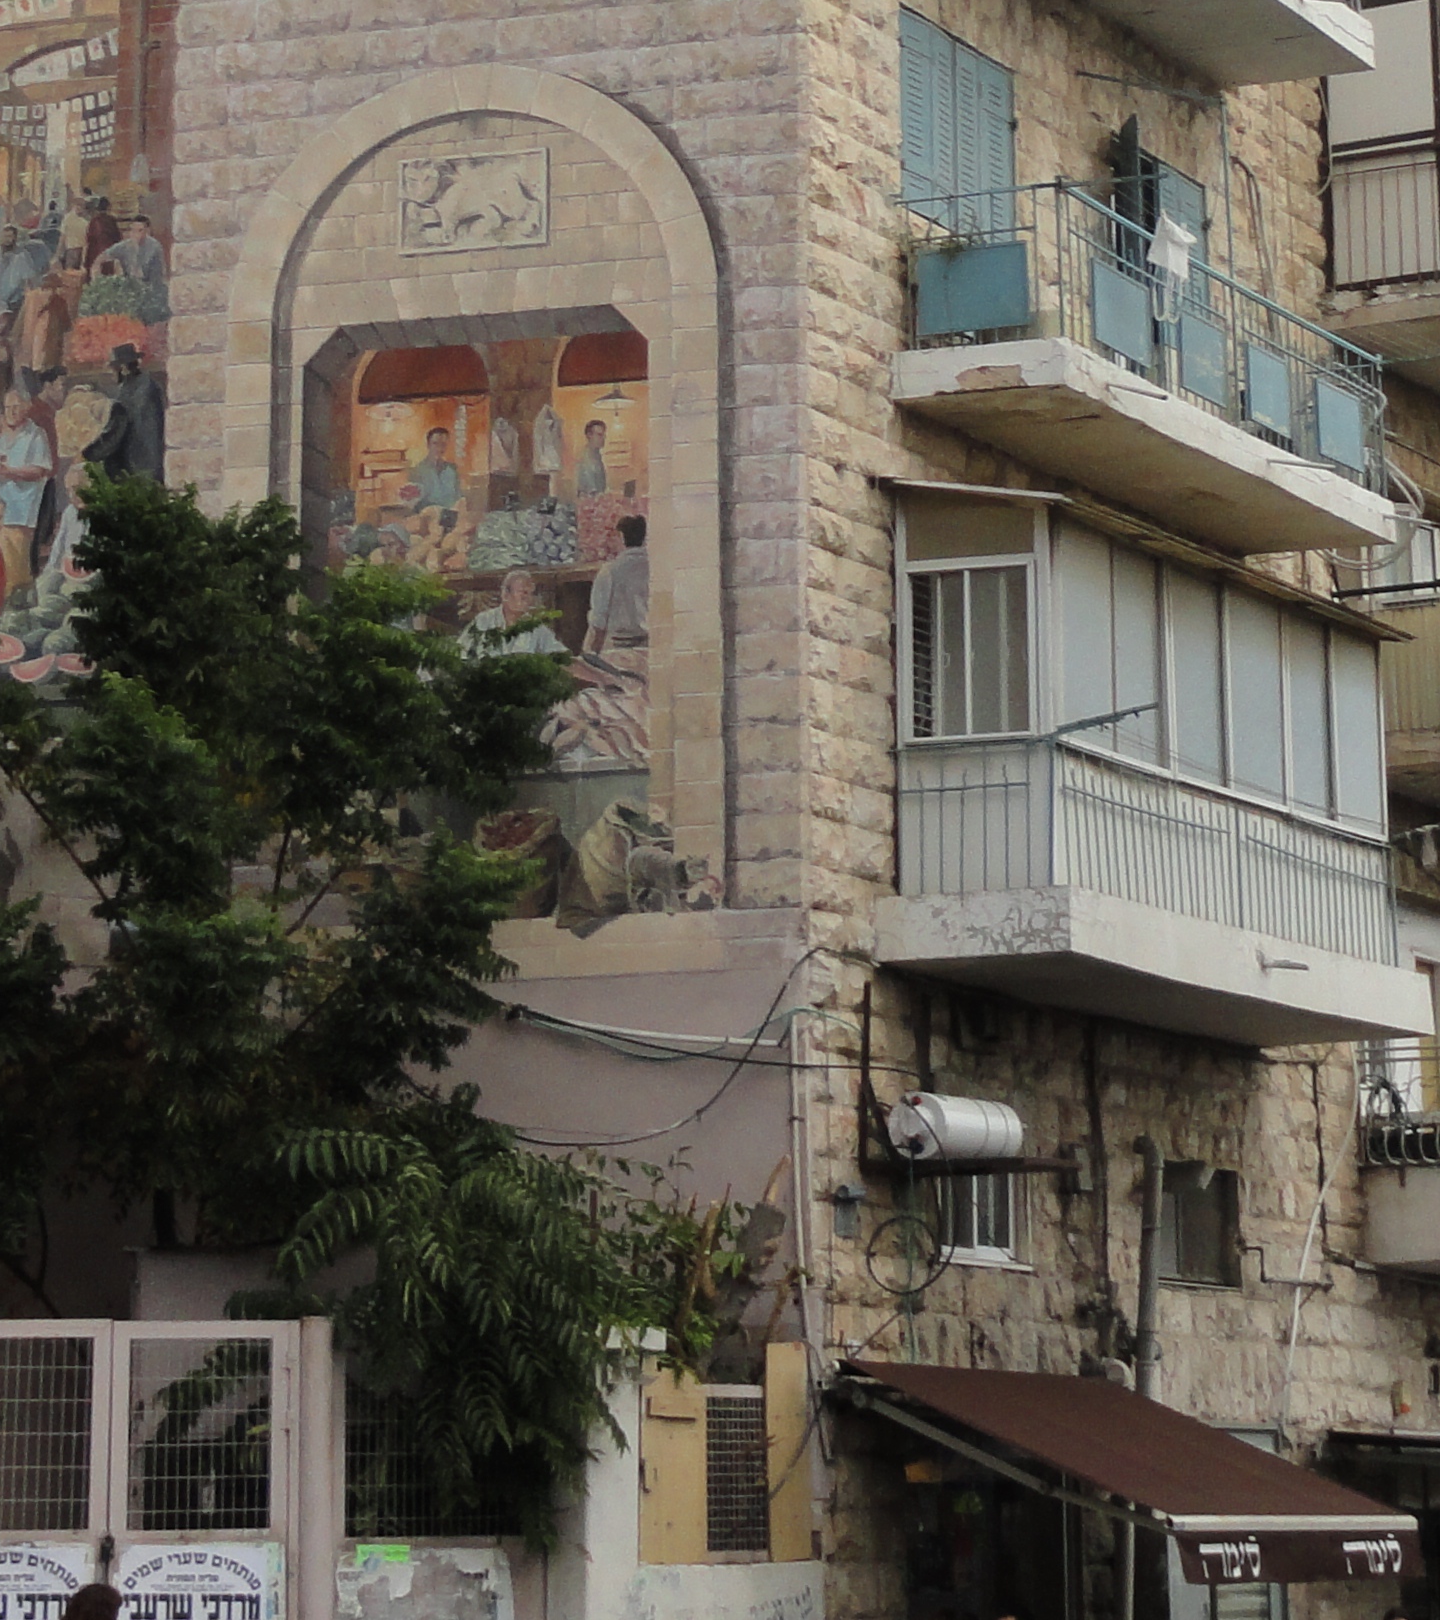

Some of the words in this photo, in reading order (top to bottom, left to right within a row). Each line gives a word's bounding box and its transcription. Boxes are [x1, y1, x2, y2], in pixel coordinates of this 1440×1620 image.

[26, 1553, 80, 1590] פותחים
[122, 1556, 164, 1590] שמים
[167, 1551, 209, 1565] שערי
[210, 1553, 262, 1591] פותחים
[123, 1593, 193, 1620] שרעבי
[201, 1593, 261, 1620] מרדכי
